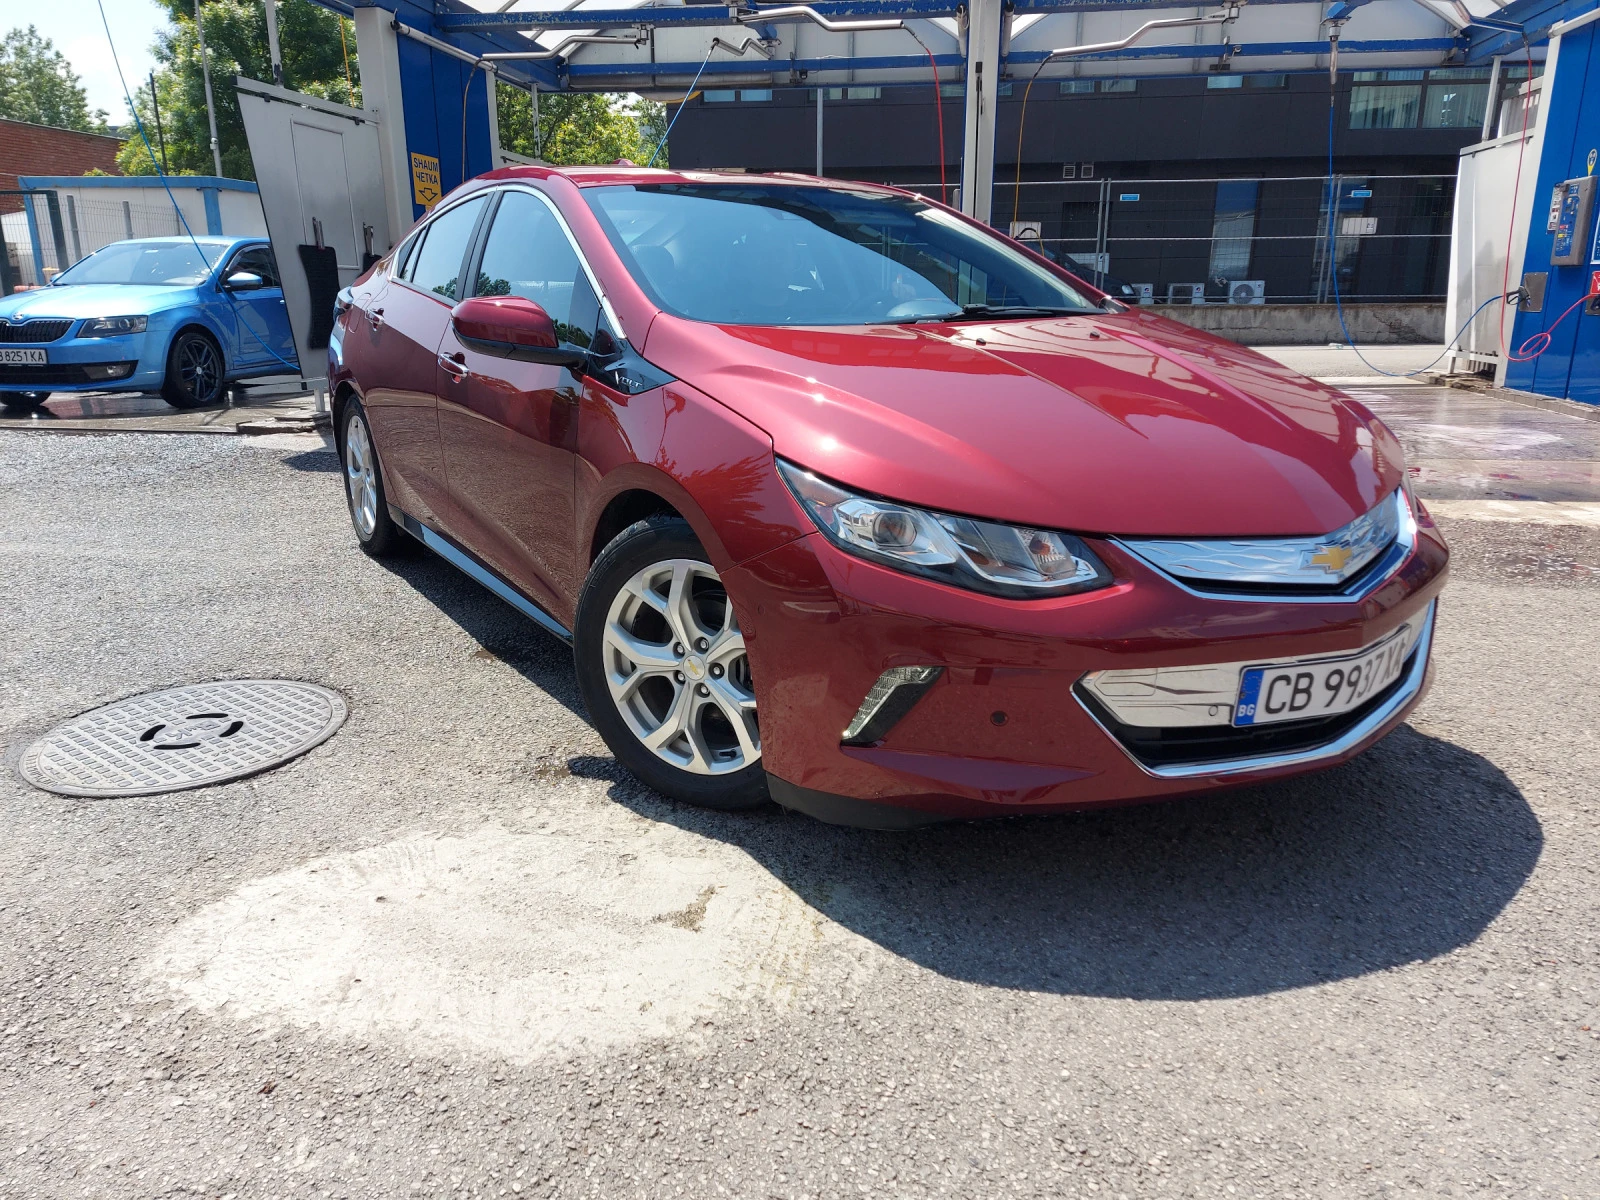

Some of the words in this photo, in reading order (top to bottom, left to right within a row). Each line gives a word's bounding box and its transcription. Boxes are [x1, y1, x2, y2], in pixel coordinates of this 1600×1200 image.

[414, 158, 438, 172] SHAUM
[416, 171, 438, 184] ЧЕТКА
[1266, 672, 1314, 714] CB
[1324, 651, 1385, 708] 9937
[1237, 703, 1256, 717] BG
